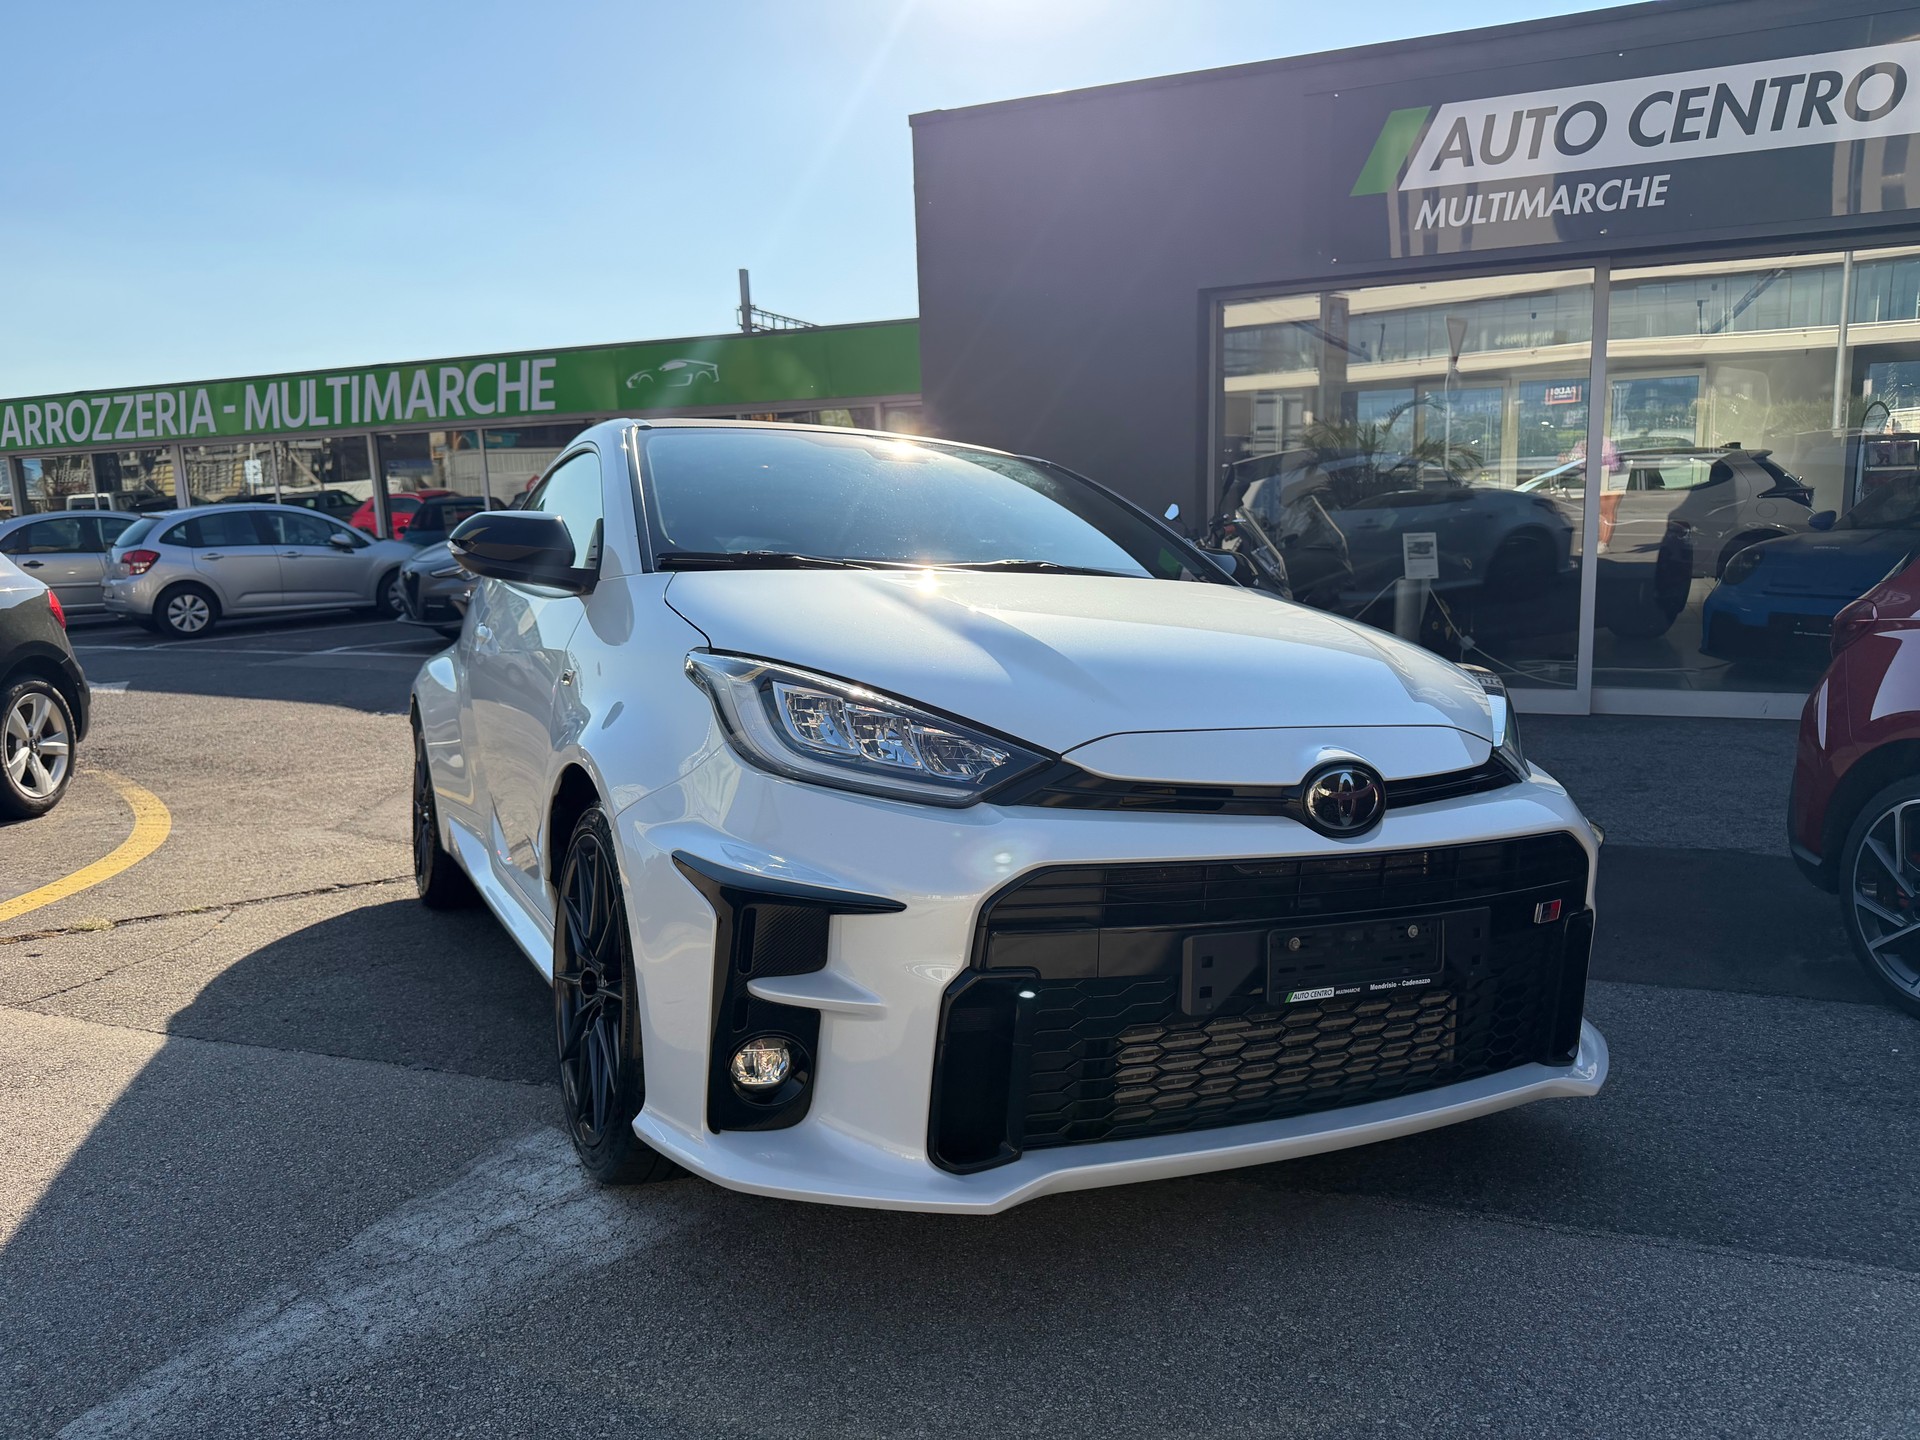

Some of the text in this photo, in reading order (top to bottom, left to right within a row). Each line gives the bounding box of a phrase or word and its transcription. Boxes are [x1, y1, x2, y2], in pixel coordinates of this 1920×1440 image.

[1429, 61, 1908, 172] AUTO CENTRO
[1414, 174, 1671, 230] MULTIMARCHE
[1, 388, 217, 448] ARROZZERIA
[244, 358, 558, 431] MULTIMARCHE
[1292, 992, 1309, 1001] AUTO
[1310, 988, 1333, 998] CENTRO
[1369, 981, 1397, 991] Mendrisio
[1401, 977, 1431, 987] Cadenazzo
